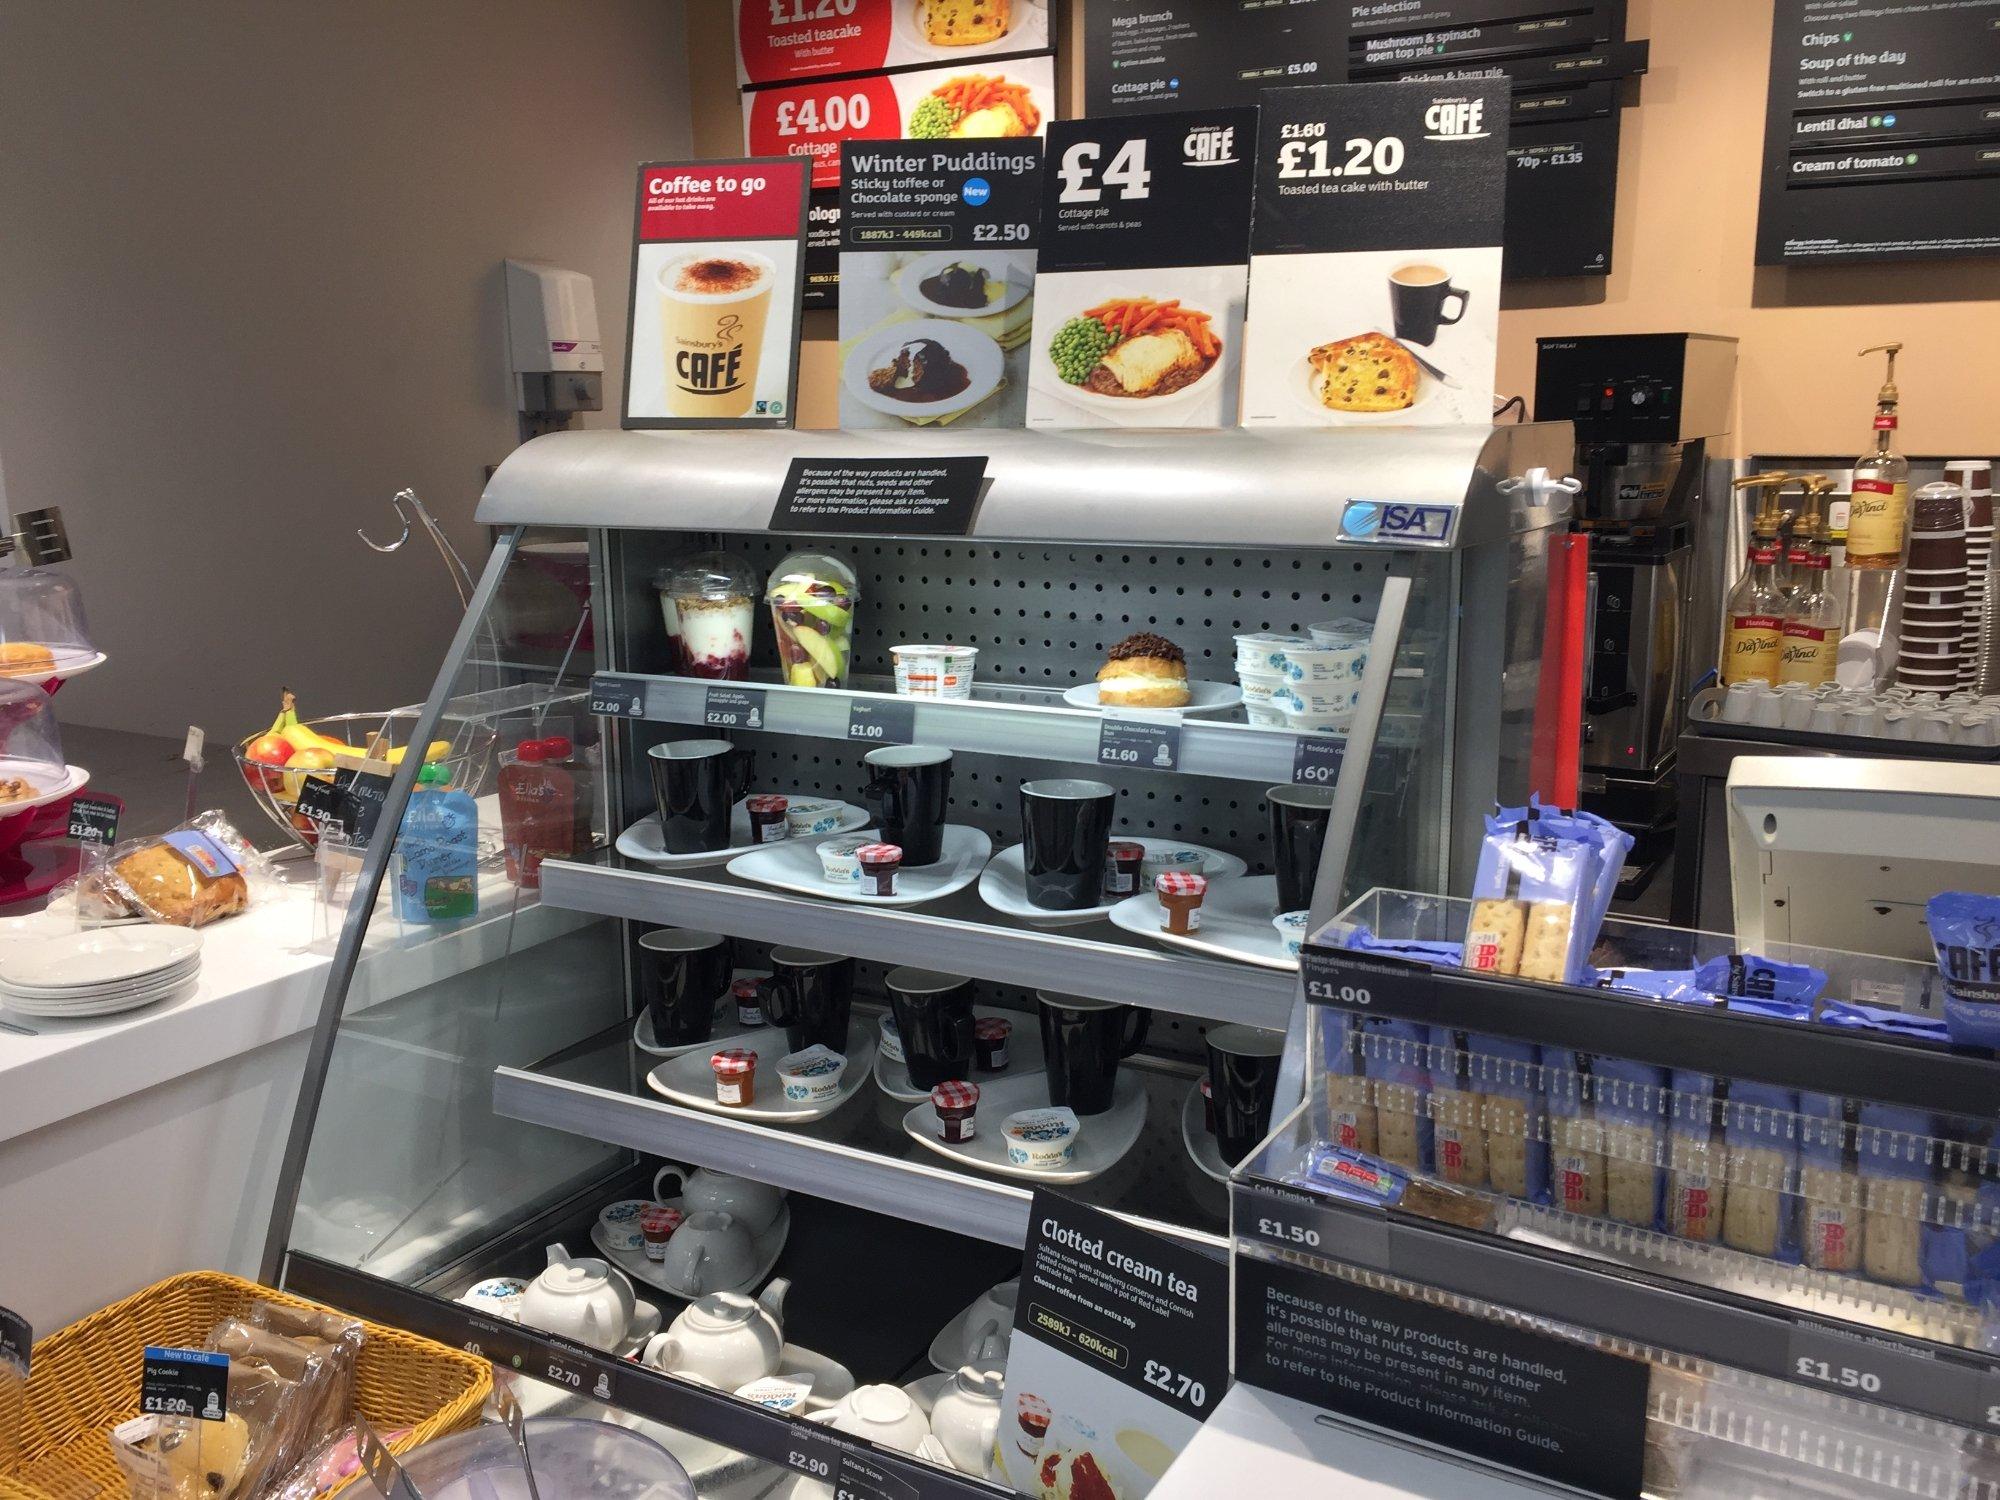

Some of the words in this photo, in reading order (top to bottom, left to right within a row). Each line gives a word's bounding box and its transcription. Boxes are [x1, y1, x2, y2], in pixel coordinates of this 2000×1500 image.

[1352, 7, 1369, 18] Pie
[1371, 1, 1421, 15] selection
[1112, 17, 1137, 28] Mega
[1139, 10, 1173, 23] brunch
[767, 30, 812, 47] Toasted
[814, 24, 861, 41] teacake
[1367, 35, 1423, 50] Mushroom
[1426, 34, 1434, 43] &
[1436, 28, 1481, 43] spinach
[1801, 33, 1840, 47] Chips
[1366, 51, 1393, 63] open
[1395, 48, 1414, 60] top
[1416, 45, 1434, 57] pie
[1800, 57, 1834, 71] Soup
[1836, 54, 1852, 67] of
[1853, 53, 1876, 65] the
[1879, 50, 1907, 65] day
[1288, 62, 1318, 75] £5.00
[1112, 82, 1149, 93] Cottage
[1150, 79, 1166, 92] pie
[776, 93, 870, 137] £4.00
[1424, 98, 1484, 135] CAFÉ
[1281, 122, 1327, 139] £1.60
[1797, 120, 1834, 133] Lentil
[1837, 116, 1868, 130] dhal
[788, 142, 837, 157] Cottage
[1183, 127, 1234, 161] CAFÉ
[851, 154, 926, 174] Winter
[932, 152, 1036, 173] Puddings
[1277, 137, 1405, 179] £1.20
[1793, 161, 1835, 172] Cream
[1837, 158, 1853, 169] of
[1854, 156, 1904, 168] tomato
[1057, 139, 1151, 203] £4
[649, 176, 712, 195] Coffee
[715, 175, 737, 192] to
[741, 177, 766, 196] go
[851, 177, 889, 191] Sticky
[892, 177, 928, 190] toffee
[930, 178, 945, 189] or
[964, 186, 988, 198] New
[1279, 183, 1319, 196] Toasted
[1321, 183, 1338, 194] tea
[1340, 182, 1366, 193] cake
[1368, 180, 1392, 192] with
[1395, 179, 1429, 191] butter
[851, 190, 911, 204] Chocolate
[914, 190, 958, 206] sponge
[851, 210, 875, 219] Served
[876, 210, 892, 219] with
[894, 209, 920, 218] custard
[922, 210, 932, 218] or
[1058, 208, 1093, 220] Cottage
[1094, 207, 1110, 219] pie
[972, 223, 1031, 242] £2.50
[1057, 223, 1080, 232] Served
[1095, 221, 1118, 229] carrots
[675, 336, 723, 350] Sainsbury's
[676, 343, 743, 389] CAFÉ
[803, 469, 832, 477] Because
[833, 469, 840, 477] of
[842, 469, 854, 477] the
[855, 470, 870, 478] way
[871, 469, 902, 477] products
[903, 469, 916, 477] are
[917, 469, 947, 477] handled,
[1380, 505, 1425, 531] ISA
[592, 701, 620, 713] £2.00
[707, 712, 737, 725] £2.00
[851, 724, 883, 737] £1.00
[1102, 747, 1138, 762] £1.60
[299, 803, 331, 821] £1.30
[1306, 963, 1340, 975] Fingers
[1308, 981, 1371, 1005] £1.00
[1258, 1218, 1320, 1247] £1.50
[1042, 1218, 1103, 1261] Clotted
[1107, 1250, 1163, 1287] cream
[1167, 1272, 1198, 1302] tea
[1038, 1243, 1060, 1259] Sultana
[1061, 1254, 1078, 1268] scone
[1079, 1260, 1092, 1274] with
[1093, 1268, 1126, 1290] strawberry
[1126, 1283, 1154, 1301] conserve
[1155, 1295, 1168, 1308] and
[1168, 1301, 1194, 1319] Cornish
[1267, 1286, 1323, 1313] Because
[1327, 1306, 1341, 1318] of
[1344, 1308, 1367, 1326] the
[1372, 1319, 1400, 1337] way
[1404, 1328, 1469, 1355] products
[1473, 1348, 1498, 1363] are
[1502, 1353, 1567, 1384] handled,
[164, 1350, 182, 1359] New
[183, 1352, 192, 1360] to
[1266, 1303, 1286, 1319] it's
[1290, 1312, 1345, 1336] possible
[1350, 1327, 1378, 1346] that
[1382, 1339, 1417, 1359] nuts,
[1421, 1350, 1464, 1371] seeds
[1467, 1363, 1495, 1380] and
[1500, 1372, 1542, 1393] other
[146, 1367, 156, 1376] Pig
[158, 1368, 179, 1376] Cookie
[1266, 1321, 1327, 1348] allergens
[1331, 1341, 1360, 1359] may
[1364, 1348, 1381, 1364] be
[1385, 1356, 1440, 1381] present
[1444, 1371, 1457, 1385] in
[1462, 1378, 1488, 1396] any
[1493, 1386, 1531, 1408] item.
[548, 1365, 581, 1386] £2.70
[1143, 1359, 1206, 1407] £2.70
[1796, 1357, 1881, 1392] £1.50
[145, 1396, 187, 1413] £1.20
[1266, 1352, 1279, 1366] to
[1283, 1359, 1317, 1377] refer
[1320, 1369, 1335, 1382] to
[1338, 1374, 1361, 1391] the
[1365, 1382, 1421, 1410] Product
[1425, 1400, 1512, 1436] Information
[1516, 1429, 1564, 1453] Guide.
[789, 1451, 828, 1476] £2.90
[842, 1458, 865, 1474] Sultana
[866, 1468, 883, 1481] Scone
